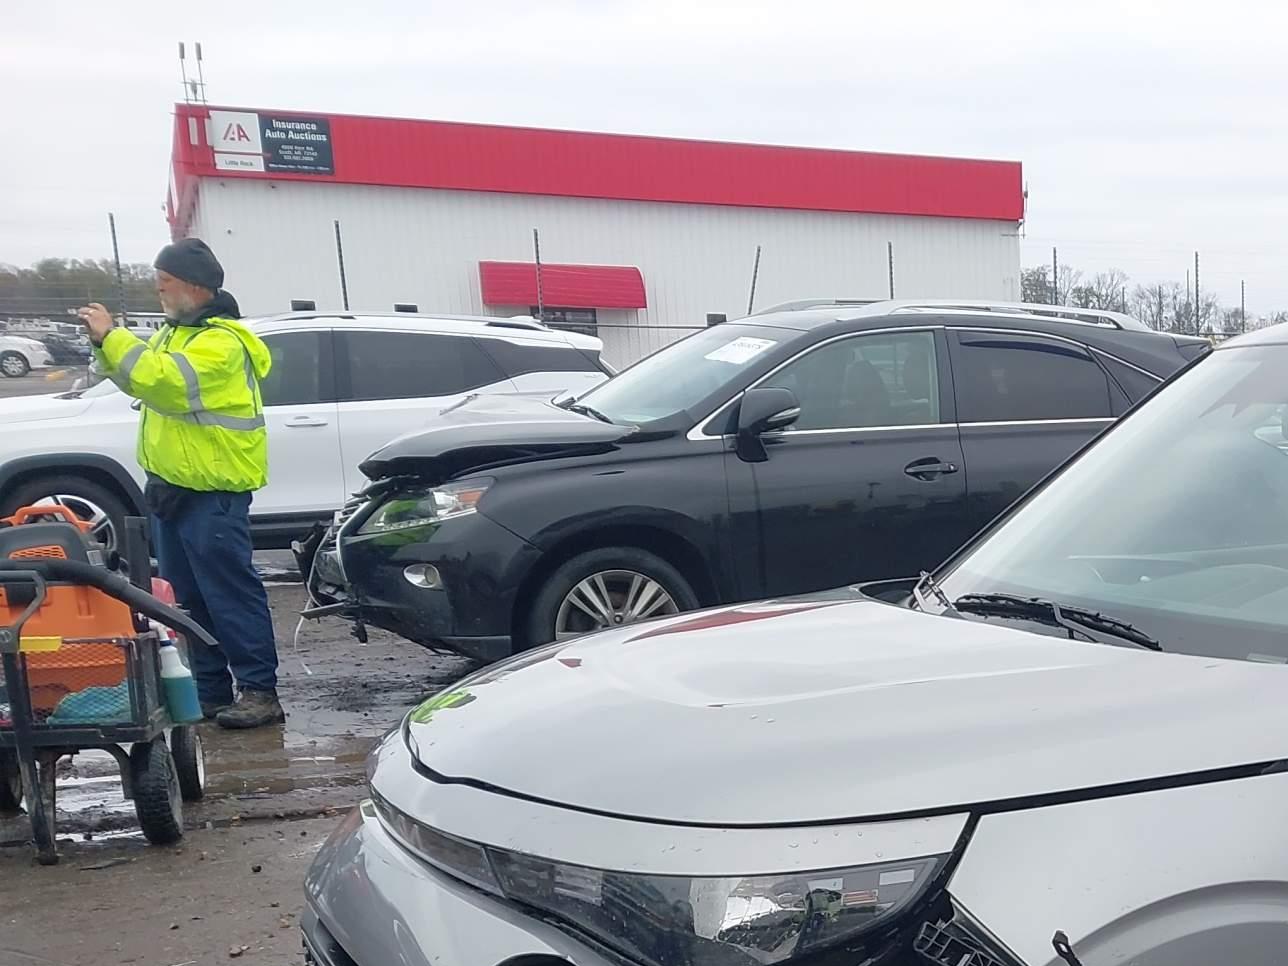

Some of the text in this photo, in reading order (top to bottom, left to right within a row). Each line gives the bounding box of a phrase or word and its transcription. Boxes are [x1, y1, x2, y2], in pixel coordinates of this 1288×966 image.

[272, 119, 317, 130] Insurance
[265, 128, 327, 141] Auto Auctions
